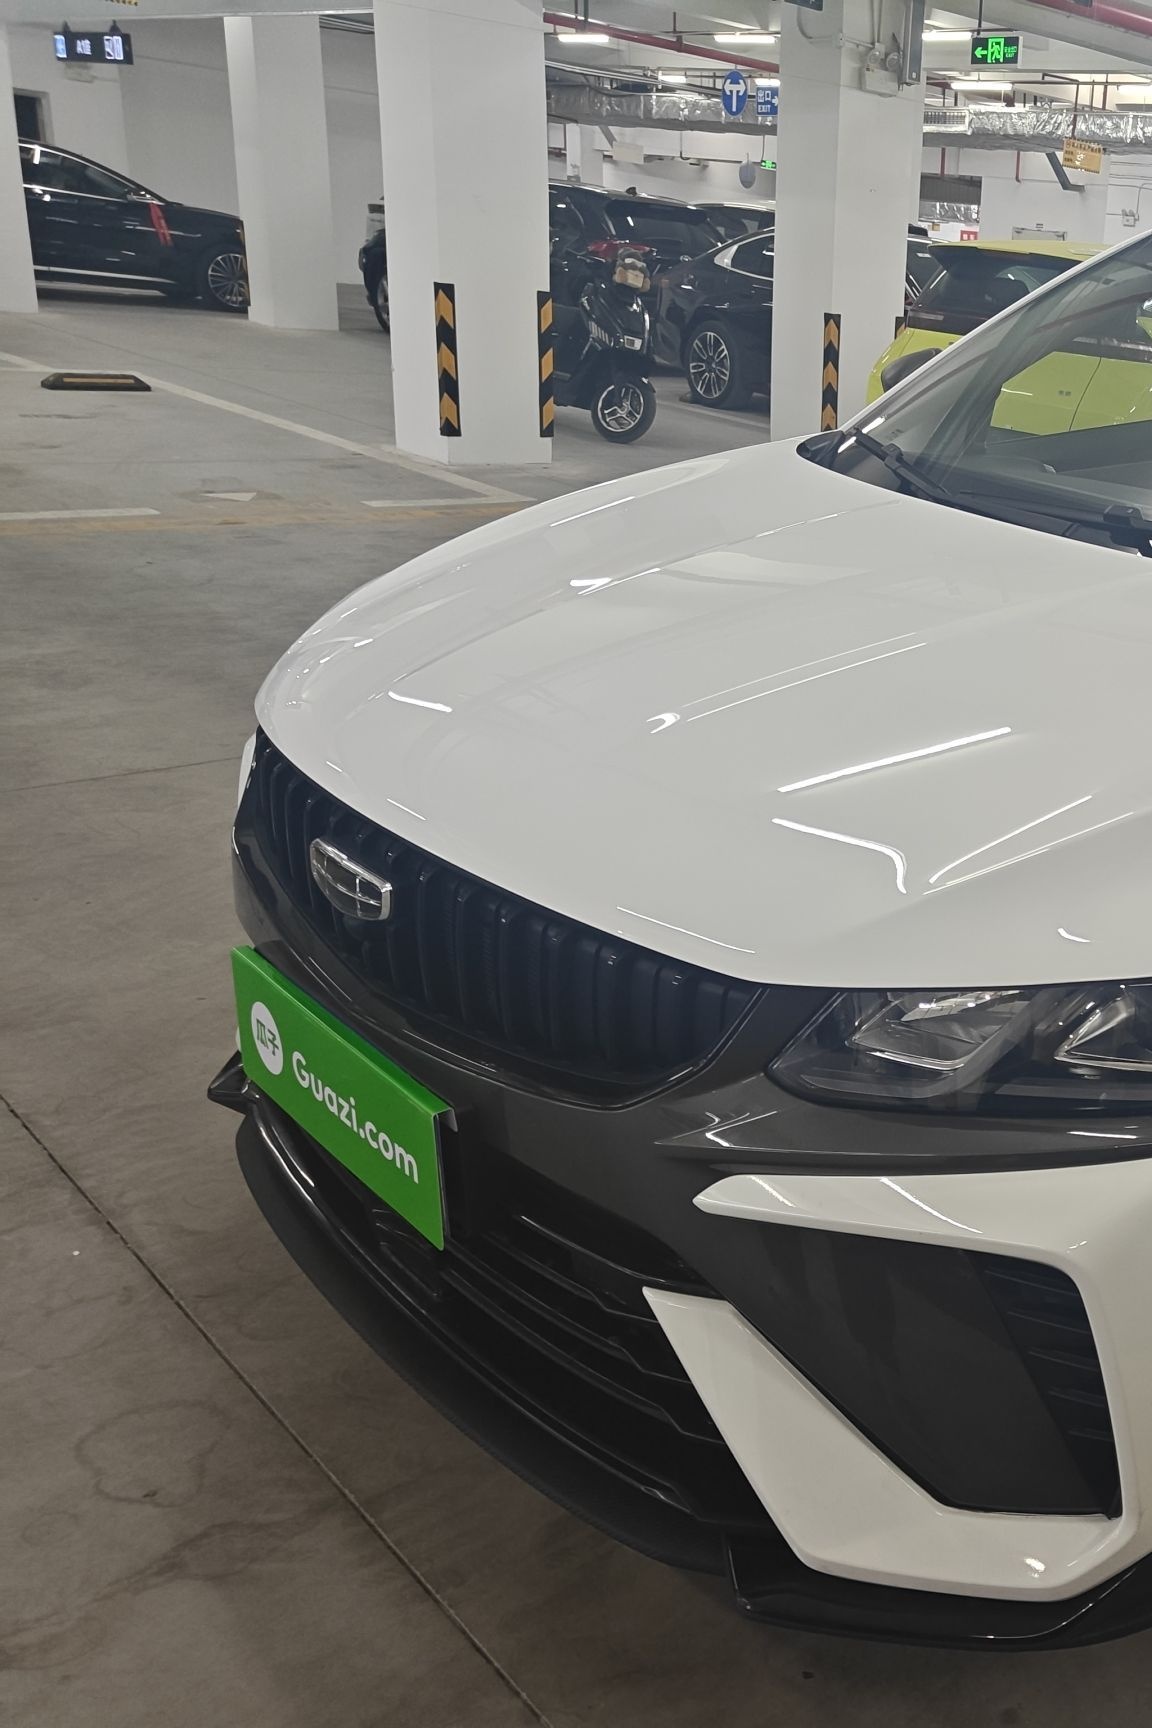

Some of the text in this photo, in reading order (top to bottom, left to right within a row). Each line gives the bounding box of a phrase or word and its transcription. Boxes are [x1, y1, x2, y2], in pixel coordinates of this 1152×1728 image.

[757, 89, 772, 103] 出口
[757, 104, 772, 113] EXIT
[291, 1050, 420, 1185] Guazi.com
